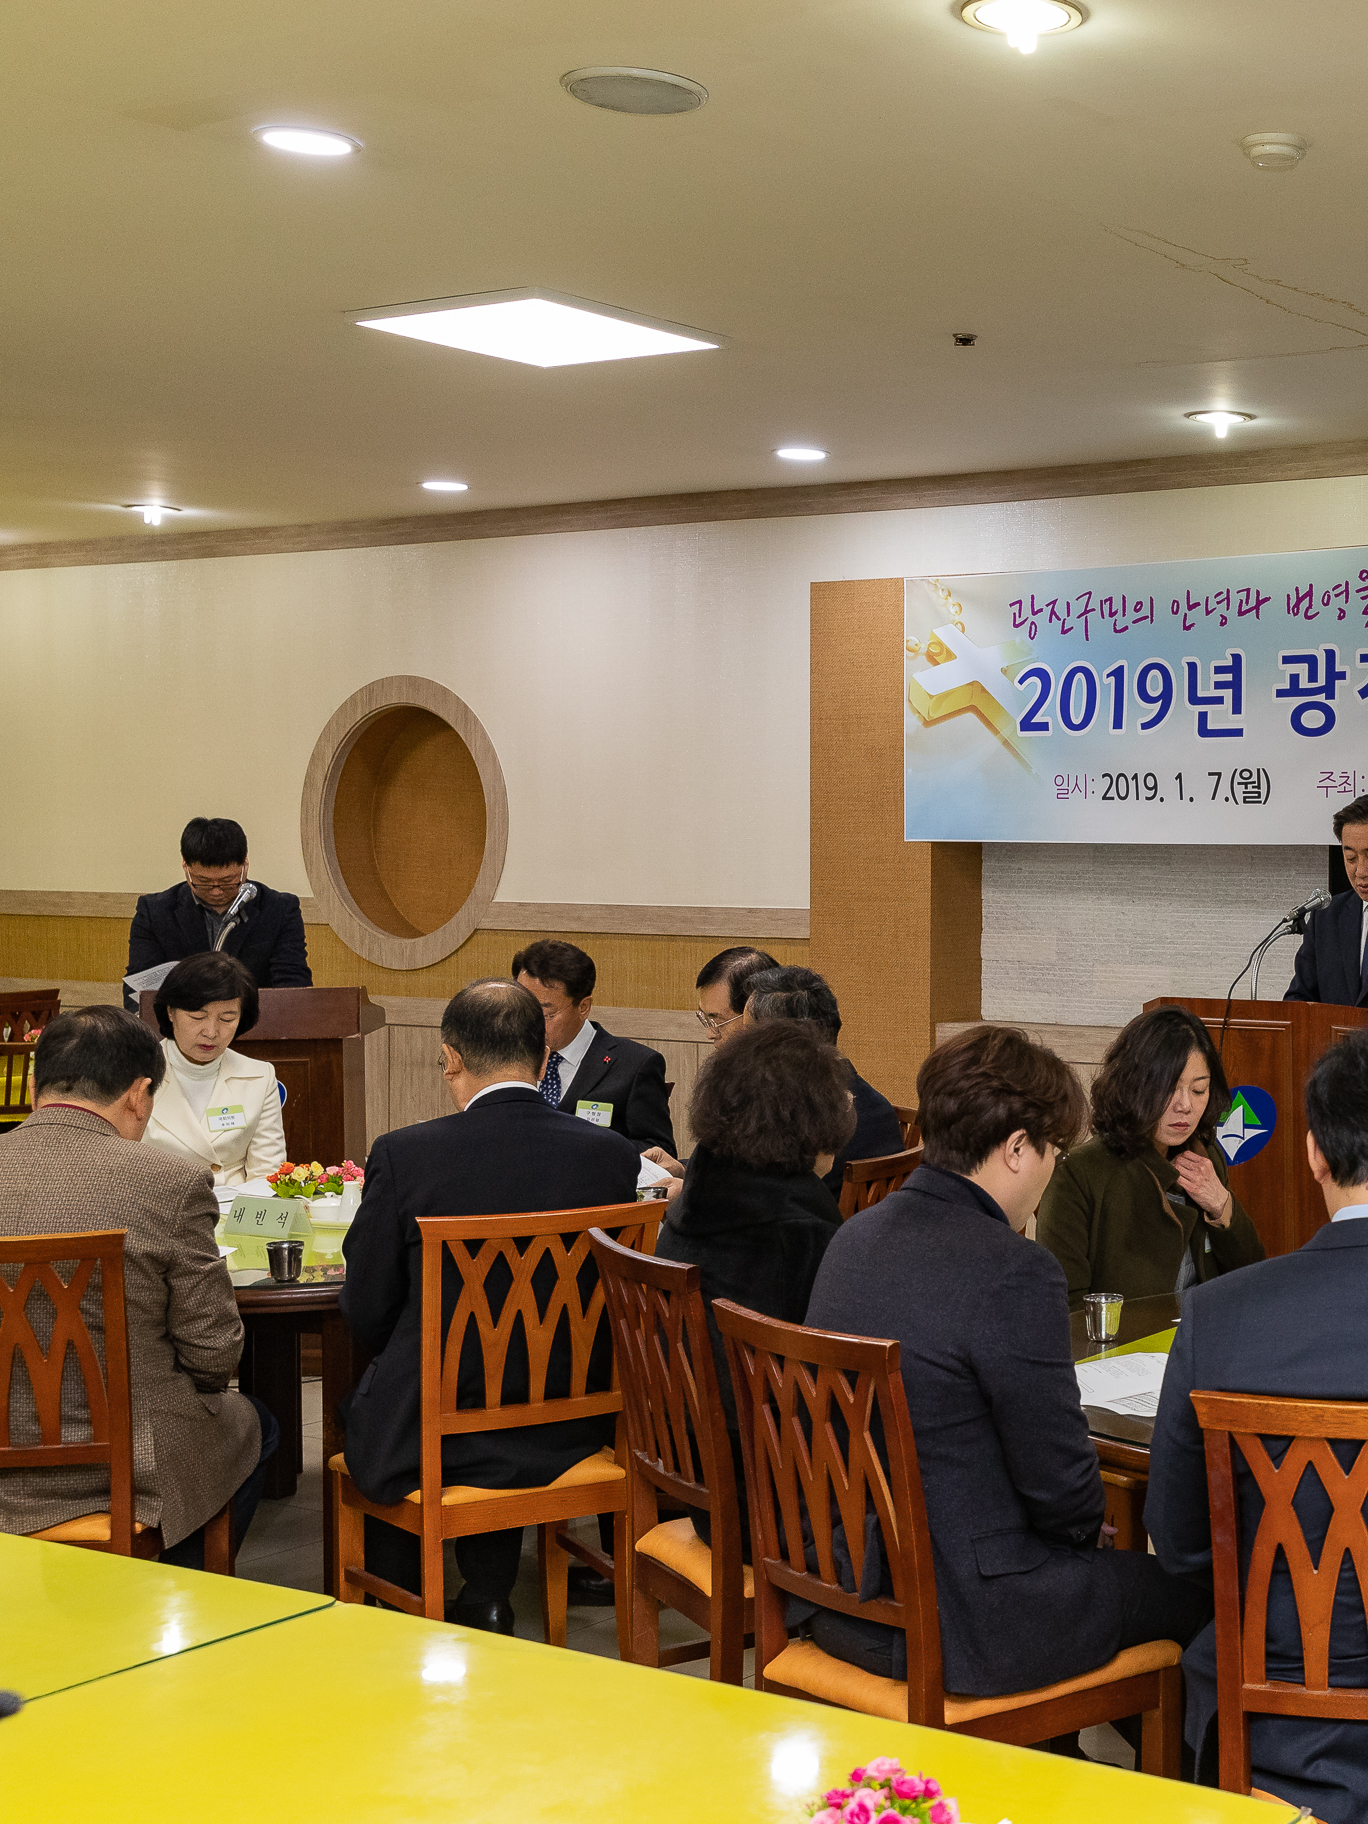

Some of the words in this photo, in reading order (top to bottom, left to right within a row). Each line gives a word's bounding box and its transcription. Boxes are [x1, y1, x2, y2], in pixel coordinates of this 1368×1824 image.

[1008, 590, 1155, 642] 광진구민의
[1170, 587, 1272, 632] 안녕과
[1017, 652, 1245, 739] 2019년
[1053, 772, 1096, 800] 일시:
[1101, 772, 1166, 803] 2019.
[1174, 772, 1195, 803] 1.
[1207, 767, 1271, 806] 7.(월)
[1316, 770, 1366, 798] 주최:
